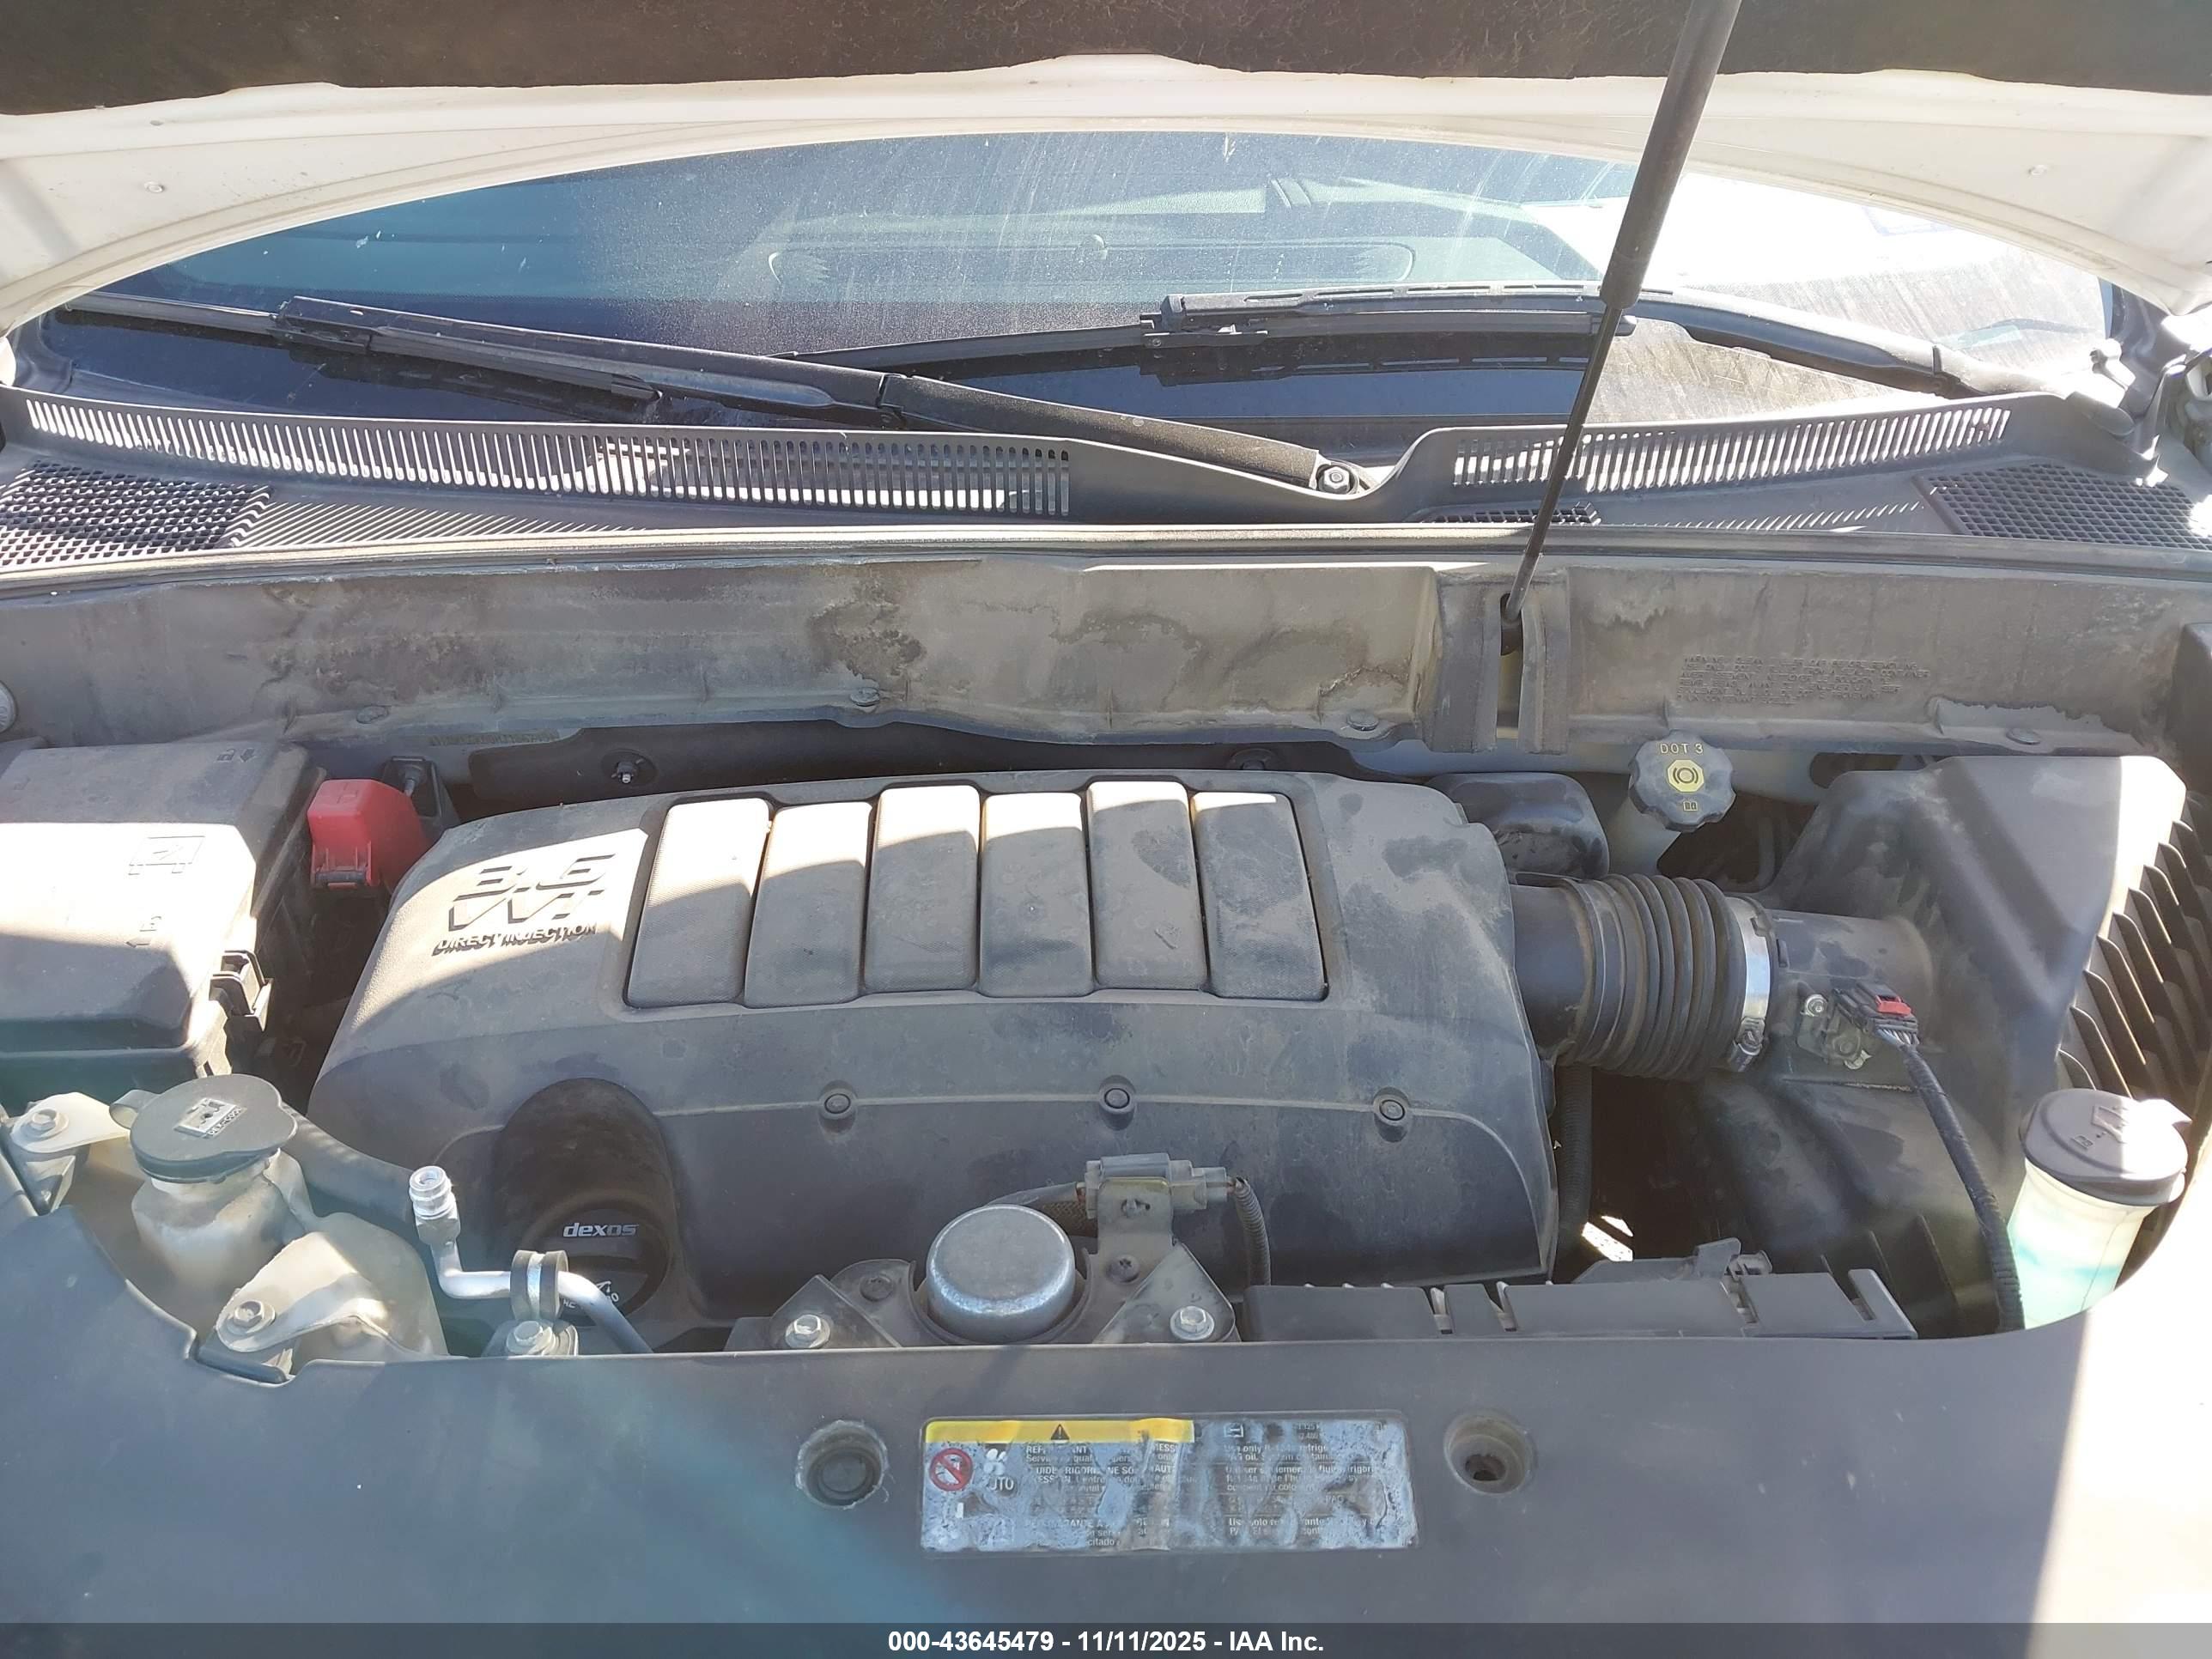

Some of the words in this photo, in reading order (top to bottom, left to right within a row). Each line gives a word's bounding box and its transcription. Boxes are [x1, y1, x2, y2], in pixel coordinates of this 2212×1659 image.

[1660, 743, 1691, 754] DOT
[1695, 743, 1704, 754] 3
[431, 933, 501, 957] DIRECT
[500, 922, 599, 948] INJECTION
[562, 1222, 640, 1237] dexos
[1242, 1444, 1262, 1453] only
